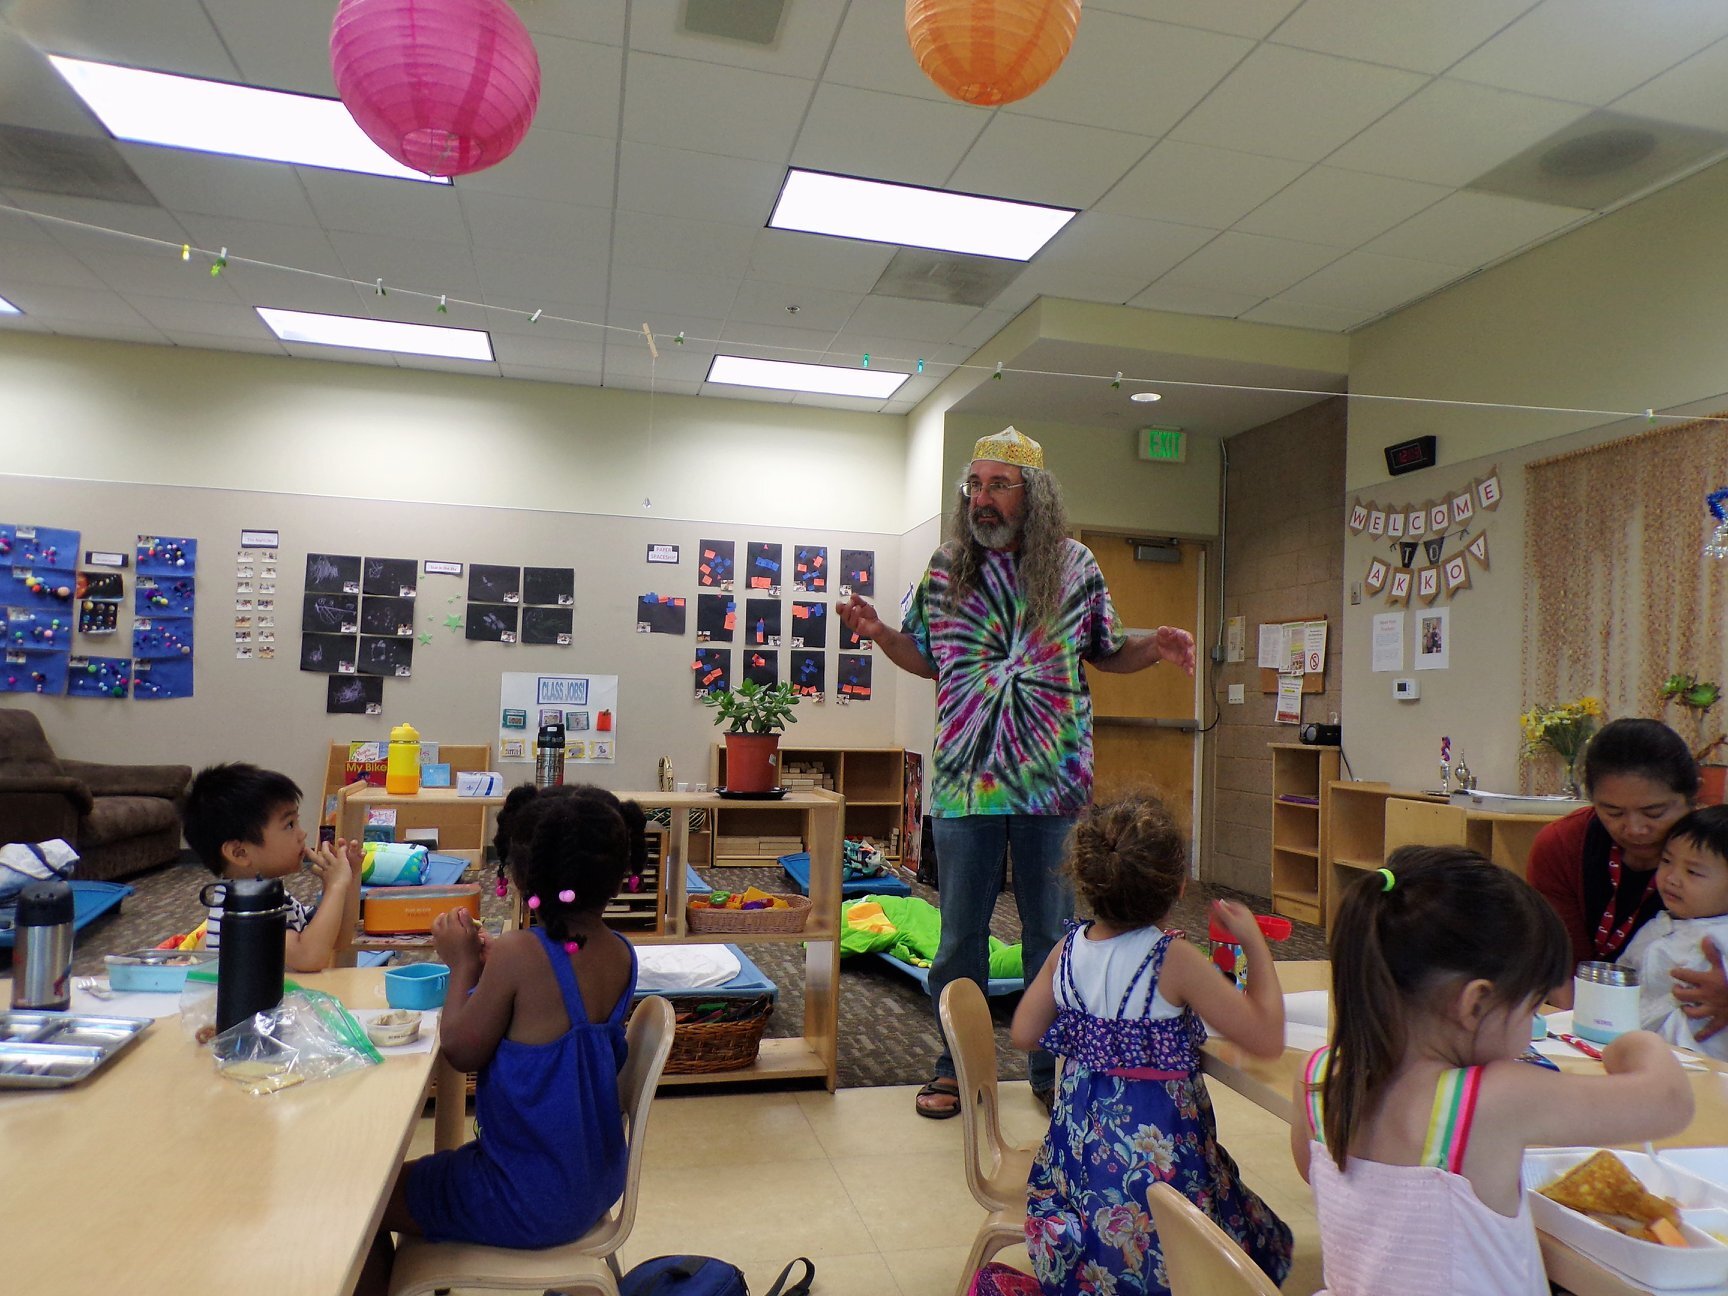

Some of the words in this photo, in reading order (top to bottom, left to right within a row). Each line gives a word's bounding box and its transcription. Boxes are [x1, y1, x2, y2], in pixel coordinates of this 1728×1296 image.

[1149, 430, 1184, 460] EXIT
[1352, 483, 1494, 531] WELCOME
[1404, 544, 1439, 564] TO
[541, 681, 564, 701] CLASS
[564, 681, 585, 702] JOBS!
[346, 762, 362, 773] My
